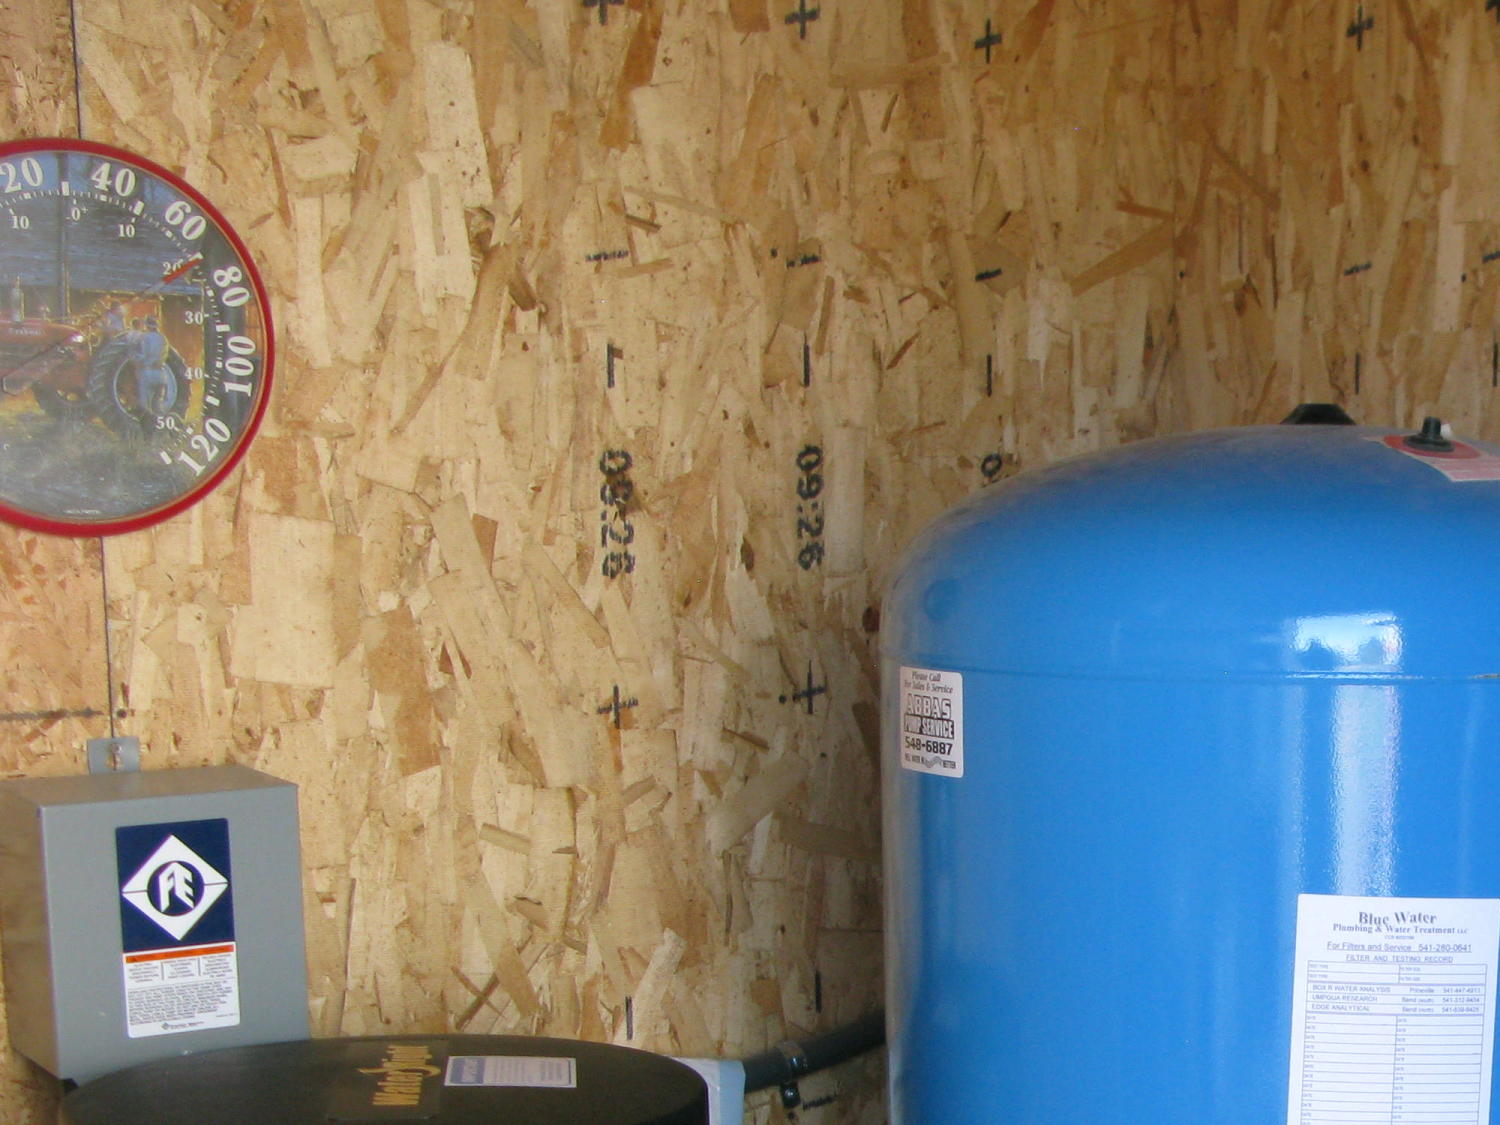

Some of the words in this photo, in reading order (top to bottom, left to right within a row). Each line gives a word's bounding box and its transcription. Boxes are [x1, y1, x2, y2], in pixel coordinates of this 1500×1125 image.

[0, 158, 43, 193] 20
[91, 162, 136, 197] 40
[11, 216, 29, 229] 10
[165, 201, 207, 240] 60
[118, 224, 136, 238] 10
[213, 266, 250, 307] 80
[185, 311, 203, 324] 30
[184, 367, 203, 380] 40
[223, 336, 256, 397] 100
[156, 417, 175, 429] 50
[178, 418, 230, 476] 120
[907, 693, 952, 720] ABBAS
[922, 718, 954, 738] SERVICE
[1333, 923, 1373, 933] Plumbing
[1415, 925, 1455, 934] Treatment
[1359, 911, 1389, 926] Blue
[1394, 911, 1437, 924] Water
